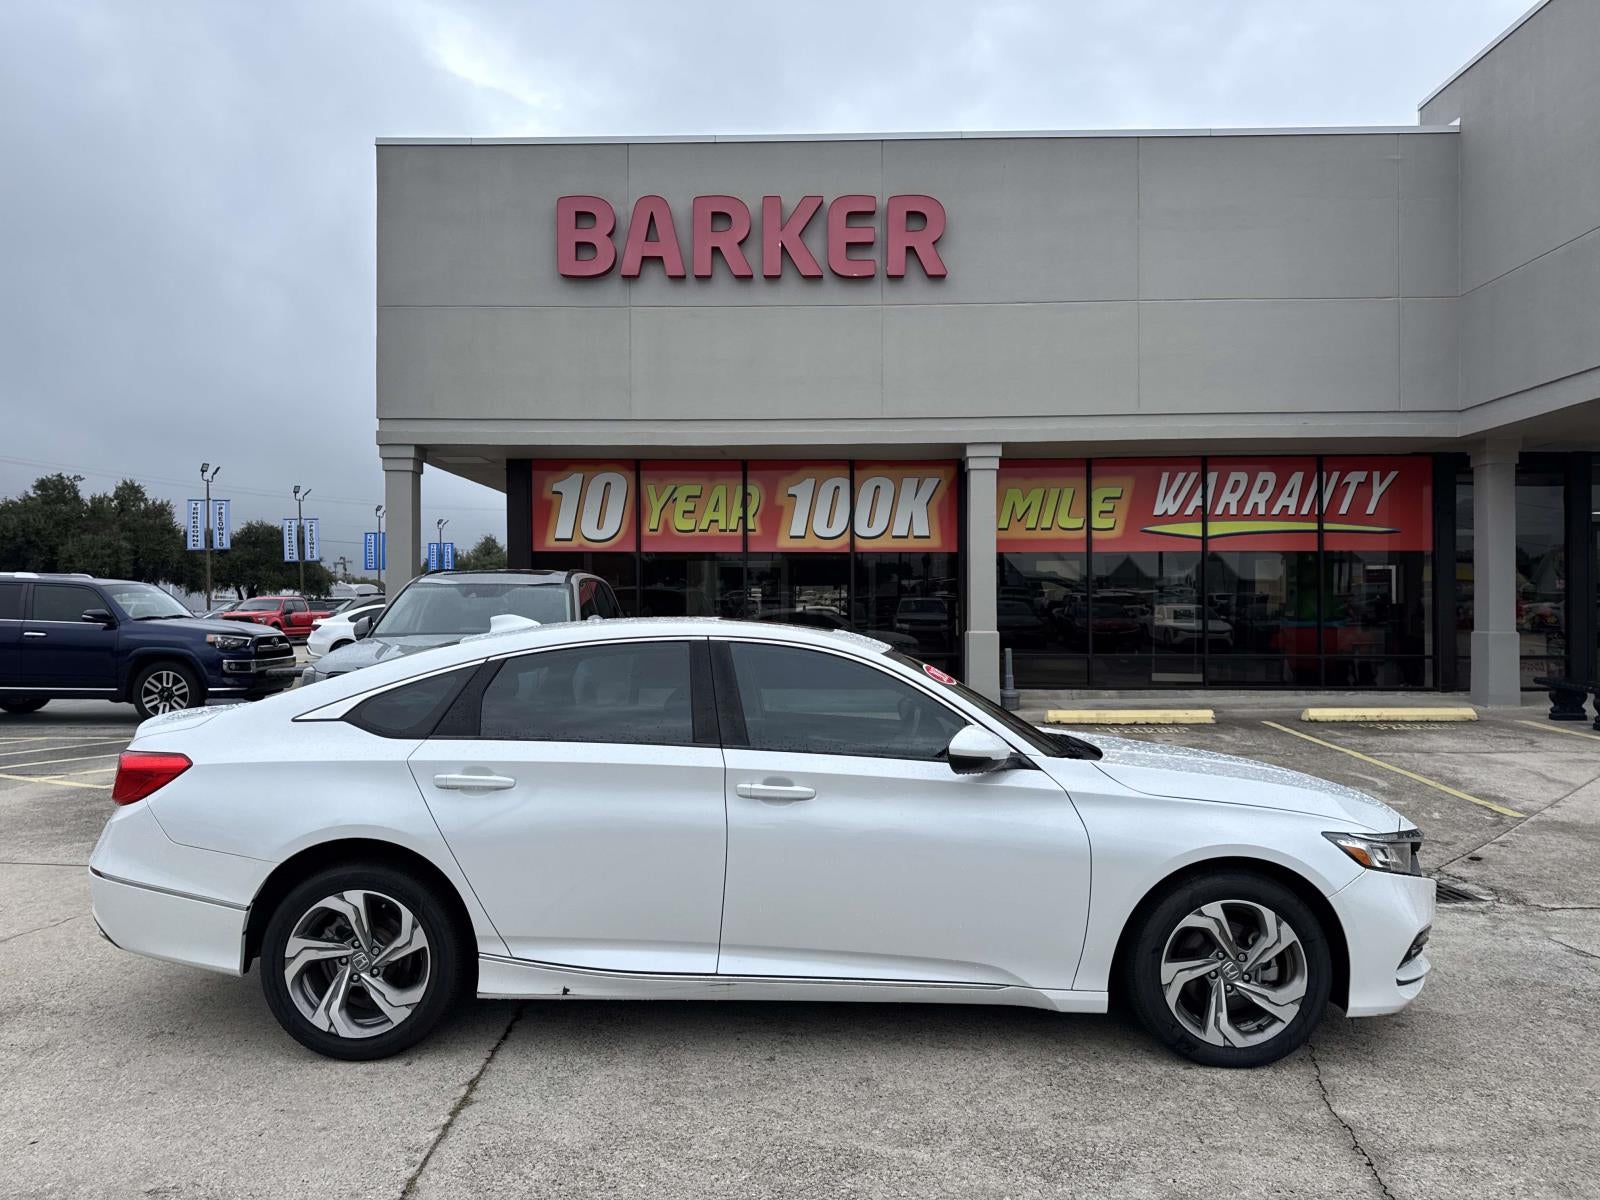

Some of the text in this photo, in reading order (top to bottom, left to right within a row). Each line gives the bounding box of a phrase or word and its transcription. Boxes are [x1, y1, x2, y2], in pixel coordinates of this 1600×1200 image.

[557, 195, 948, 279] BARKER
[217, 506, 225, 548] PREOWNED
[551, 471, 1399, 543] 10 YEAR 100K MILE WARRANTY
